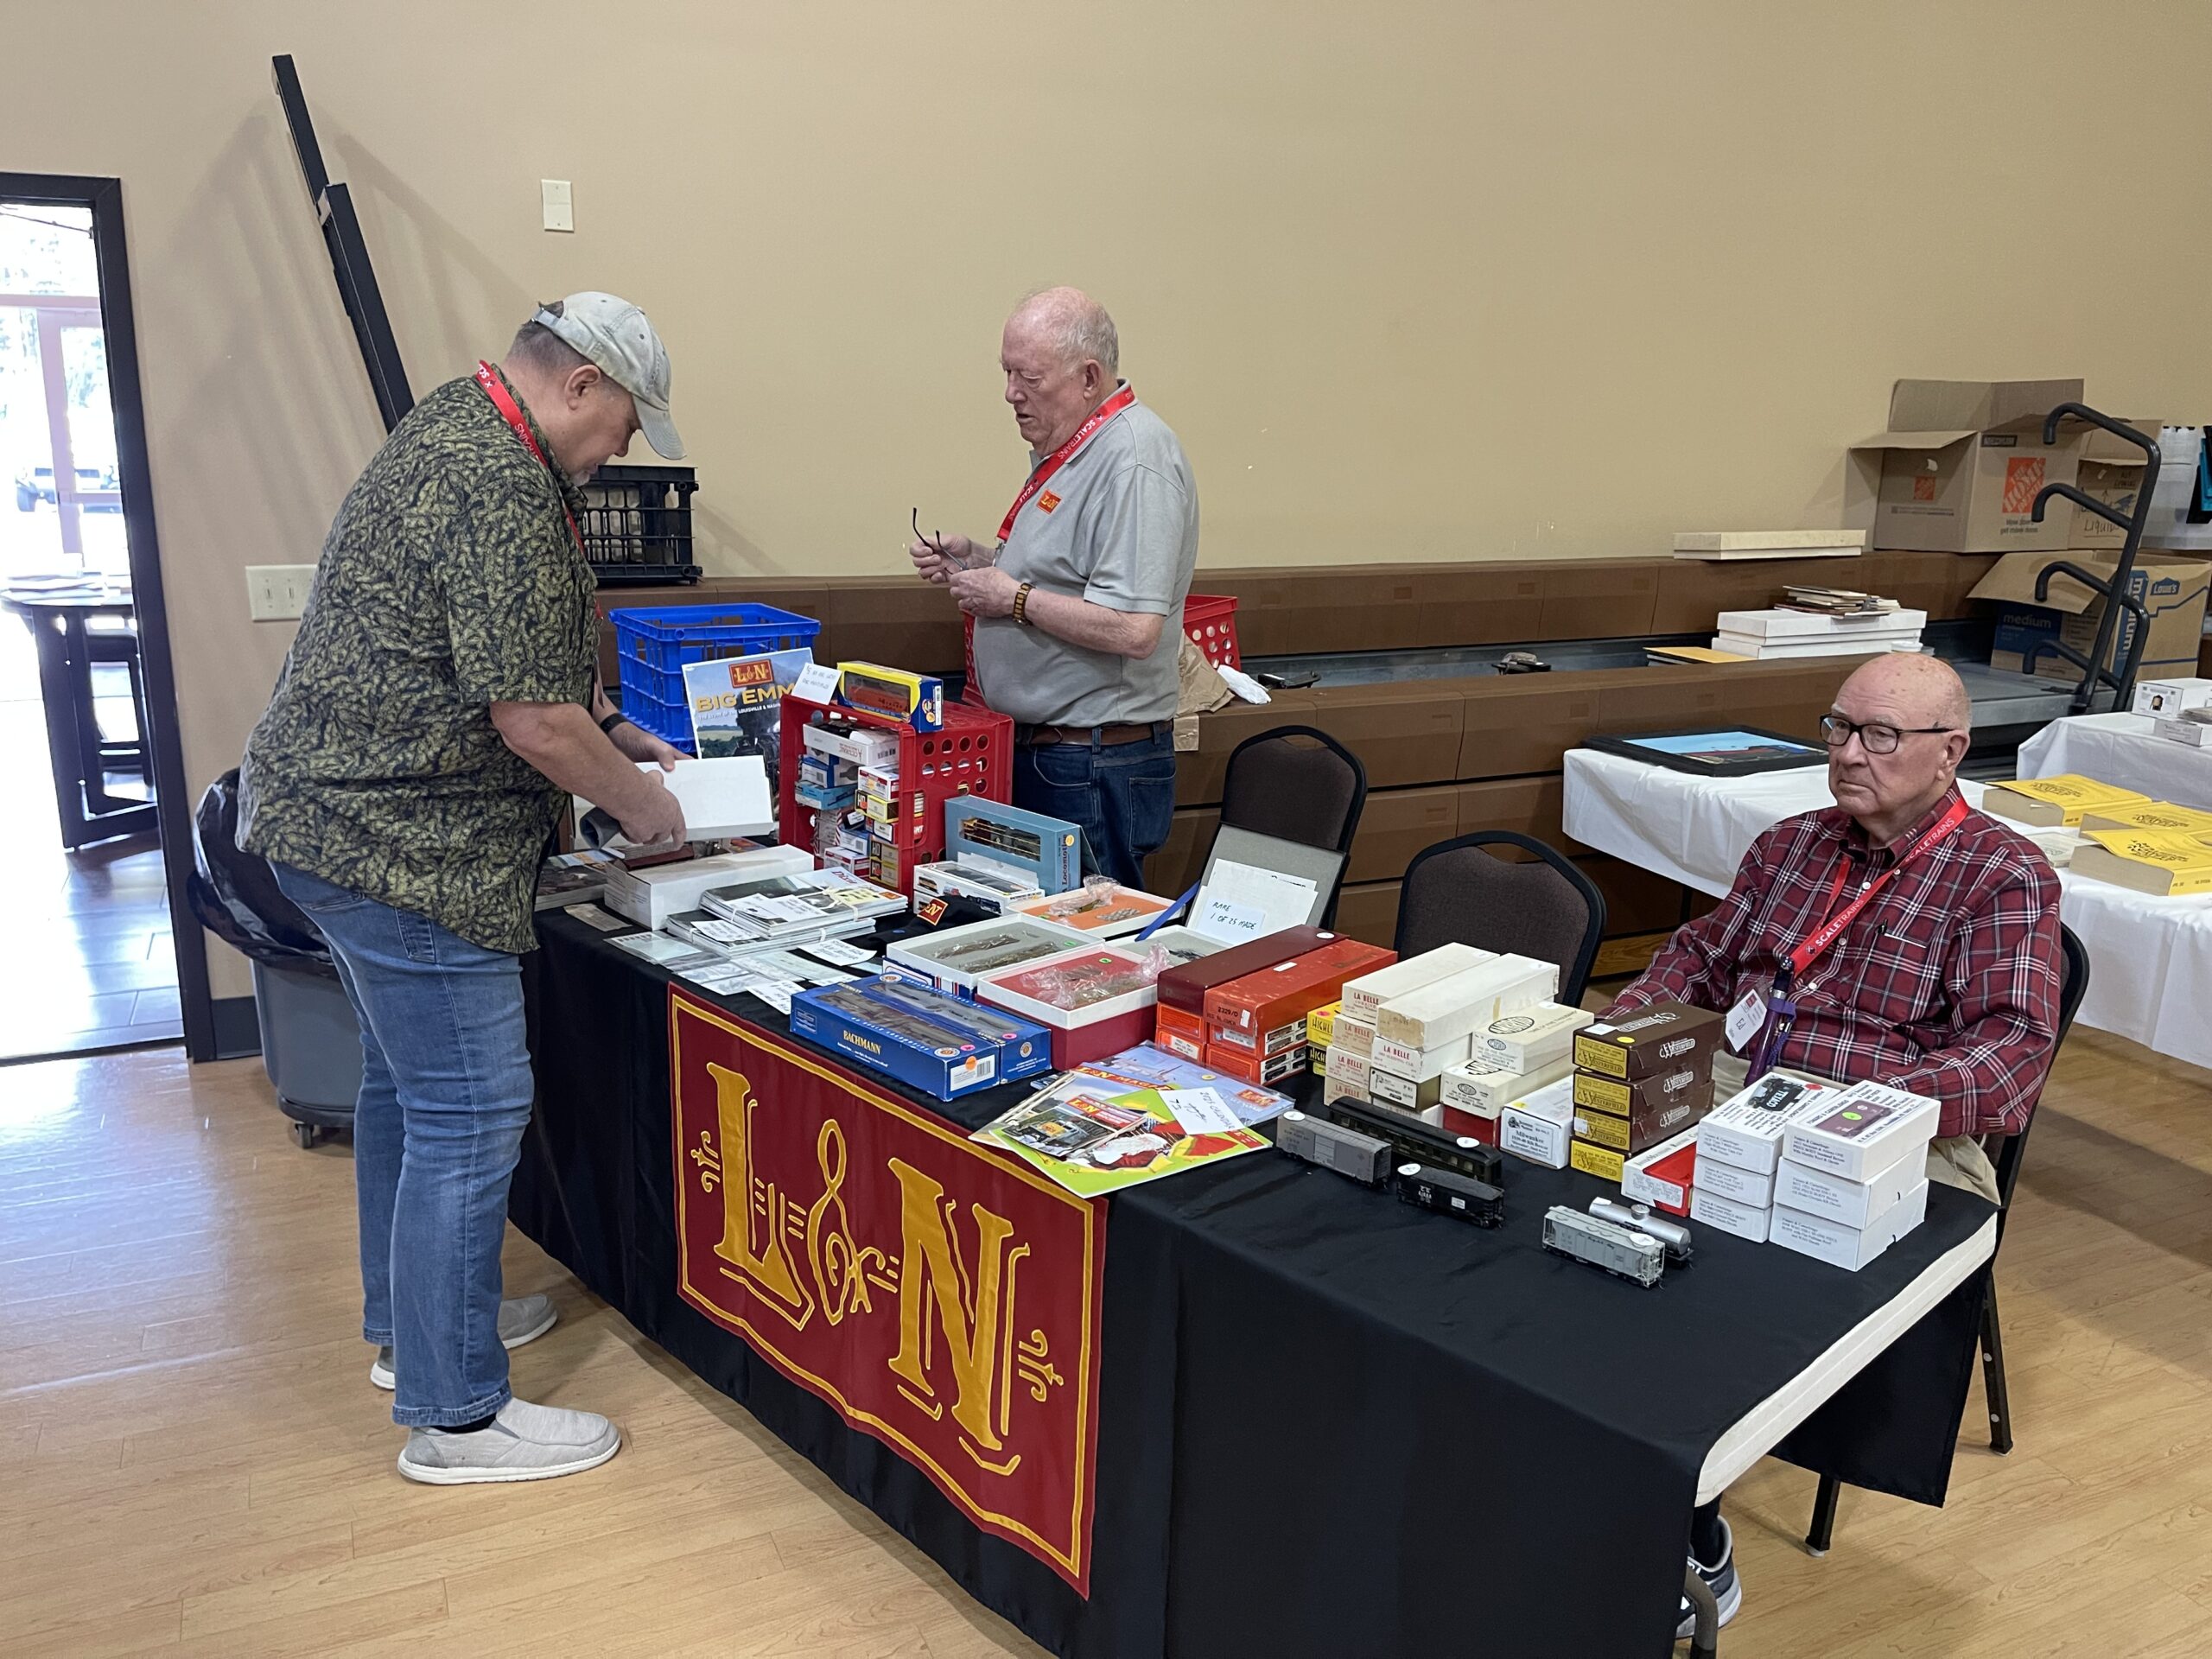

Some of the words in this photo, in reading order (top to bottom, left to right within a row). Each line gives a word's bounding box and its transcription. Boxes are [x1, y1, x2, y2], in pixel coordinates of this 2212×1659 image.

[1058, 420, 1097, 460] SCALETRAINS
[2003, 459, 2044, 512] HOME
[2003, 613, 2052, 629] medium
[734, 664, 769, 683] L&N
[696, 691, 737, 713] BIG
[742, 683, 796, 705] EMM
[738, 704, 762, 714] LOUISVILLE
[1904, 817, 1955, 862] SCALETRAINS
[1212, 901, 1231, 912] RARE
[1237, 920, 1257, 930] MADE
[1815, 899, 1864, 947] SCALETRAINS
[1353, 992, 1361, 1001] LA
[1363, 995, 1379, 1006] BELLE
[1312, 1017, 1333, 1034] HIGHLI
[1344, 1023, 1352, 1033] LA
[1354, 1026, 1370, 1038] BELLE
[842, 1029, 881, 1056] BACHMANN
[1310, 1048, 1325, 1062] HIGH
[1383, 1045, 1391, 1053] LA
[1393, 1047, 1410, 1060] BELLE
[1338, 1054, 1344, 1063] LA
[1346, 1057, 1363, 1070] BELLE
[1075, 1066, 1113, 1078] L&N
[1335, 1084, 1343, 1093] LA
[1344, 1087, 1359, 1098] BELLE
[1766, 1090, 1789, 1108] TEXACO
[1070, 1099, 1102, 1114] L&N
[708, 1062, 1030, 1475] L&N
